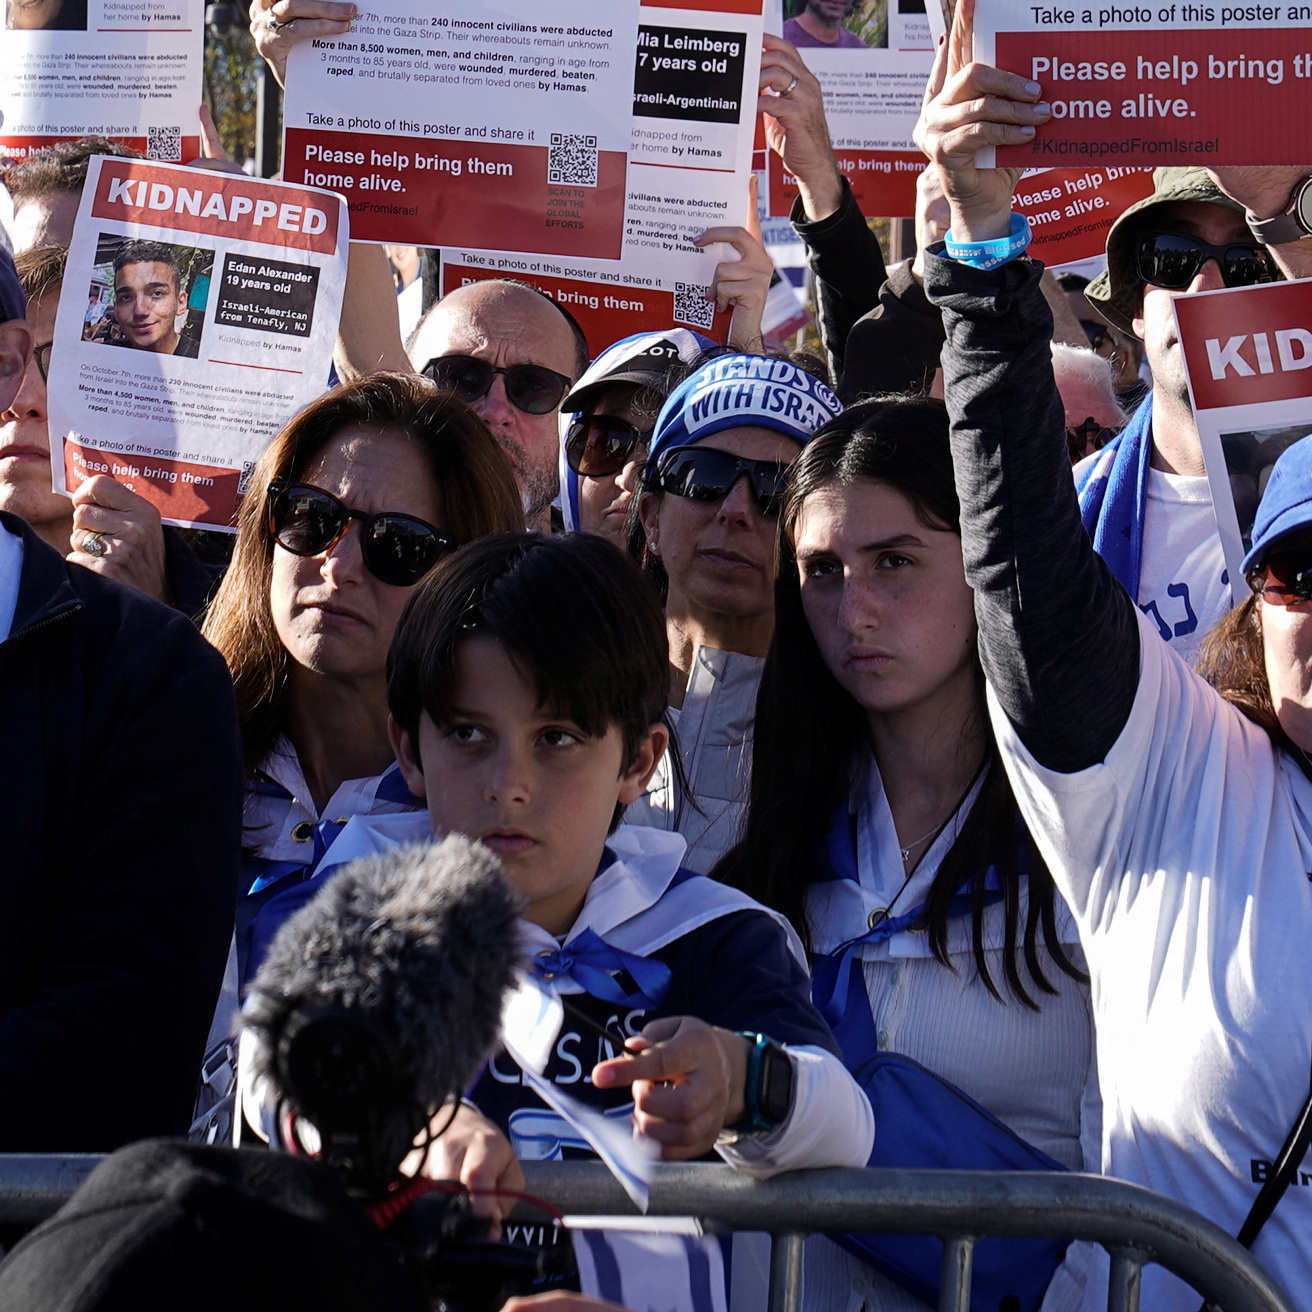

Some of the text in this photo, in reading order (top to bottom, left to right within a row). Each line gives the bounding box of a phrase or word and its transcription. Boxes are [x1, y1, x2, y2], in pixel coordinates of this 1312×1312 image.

[103, 2, 165, 12] Kidnapped from
[103, 13, 181, 23] her home by Hamas
[663, 35, 740, 57] Leimberg
[651, 56, 727, 73] years old
[1032, 56, 1127, 81] Please
[1137, 54, 1199, 85] help
[1208, 54, 1284, 85] bring
[1121, 93, 1196, 118] alive.
[1032, 136, 1219, 157] #KidnappedFromIsrael
[107, 177, 327, 235] KIDNAPPED
[228, 260, 313, 283] Edan Alexander
[226, 274, 292, 294] 19 years old
[220, 310, 307, 332] from Tenafly, NJ
[221, 299, 308, 321] Israeli-American
[218, 334, 302, 353] Kidnapped by Hamas
[696, 355, 810, 392] STANDS
[691, 383, 754, 423] WITH
